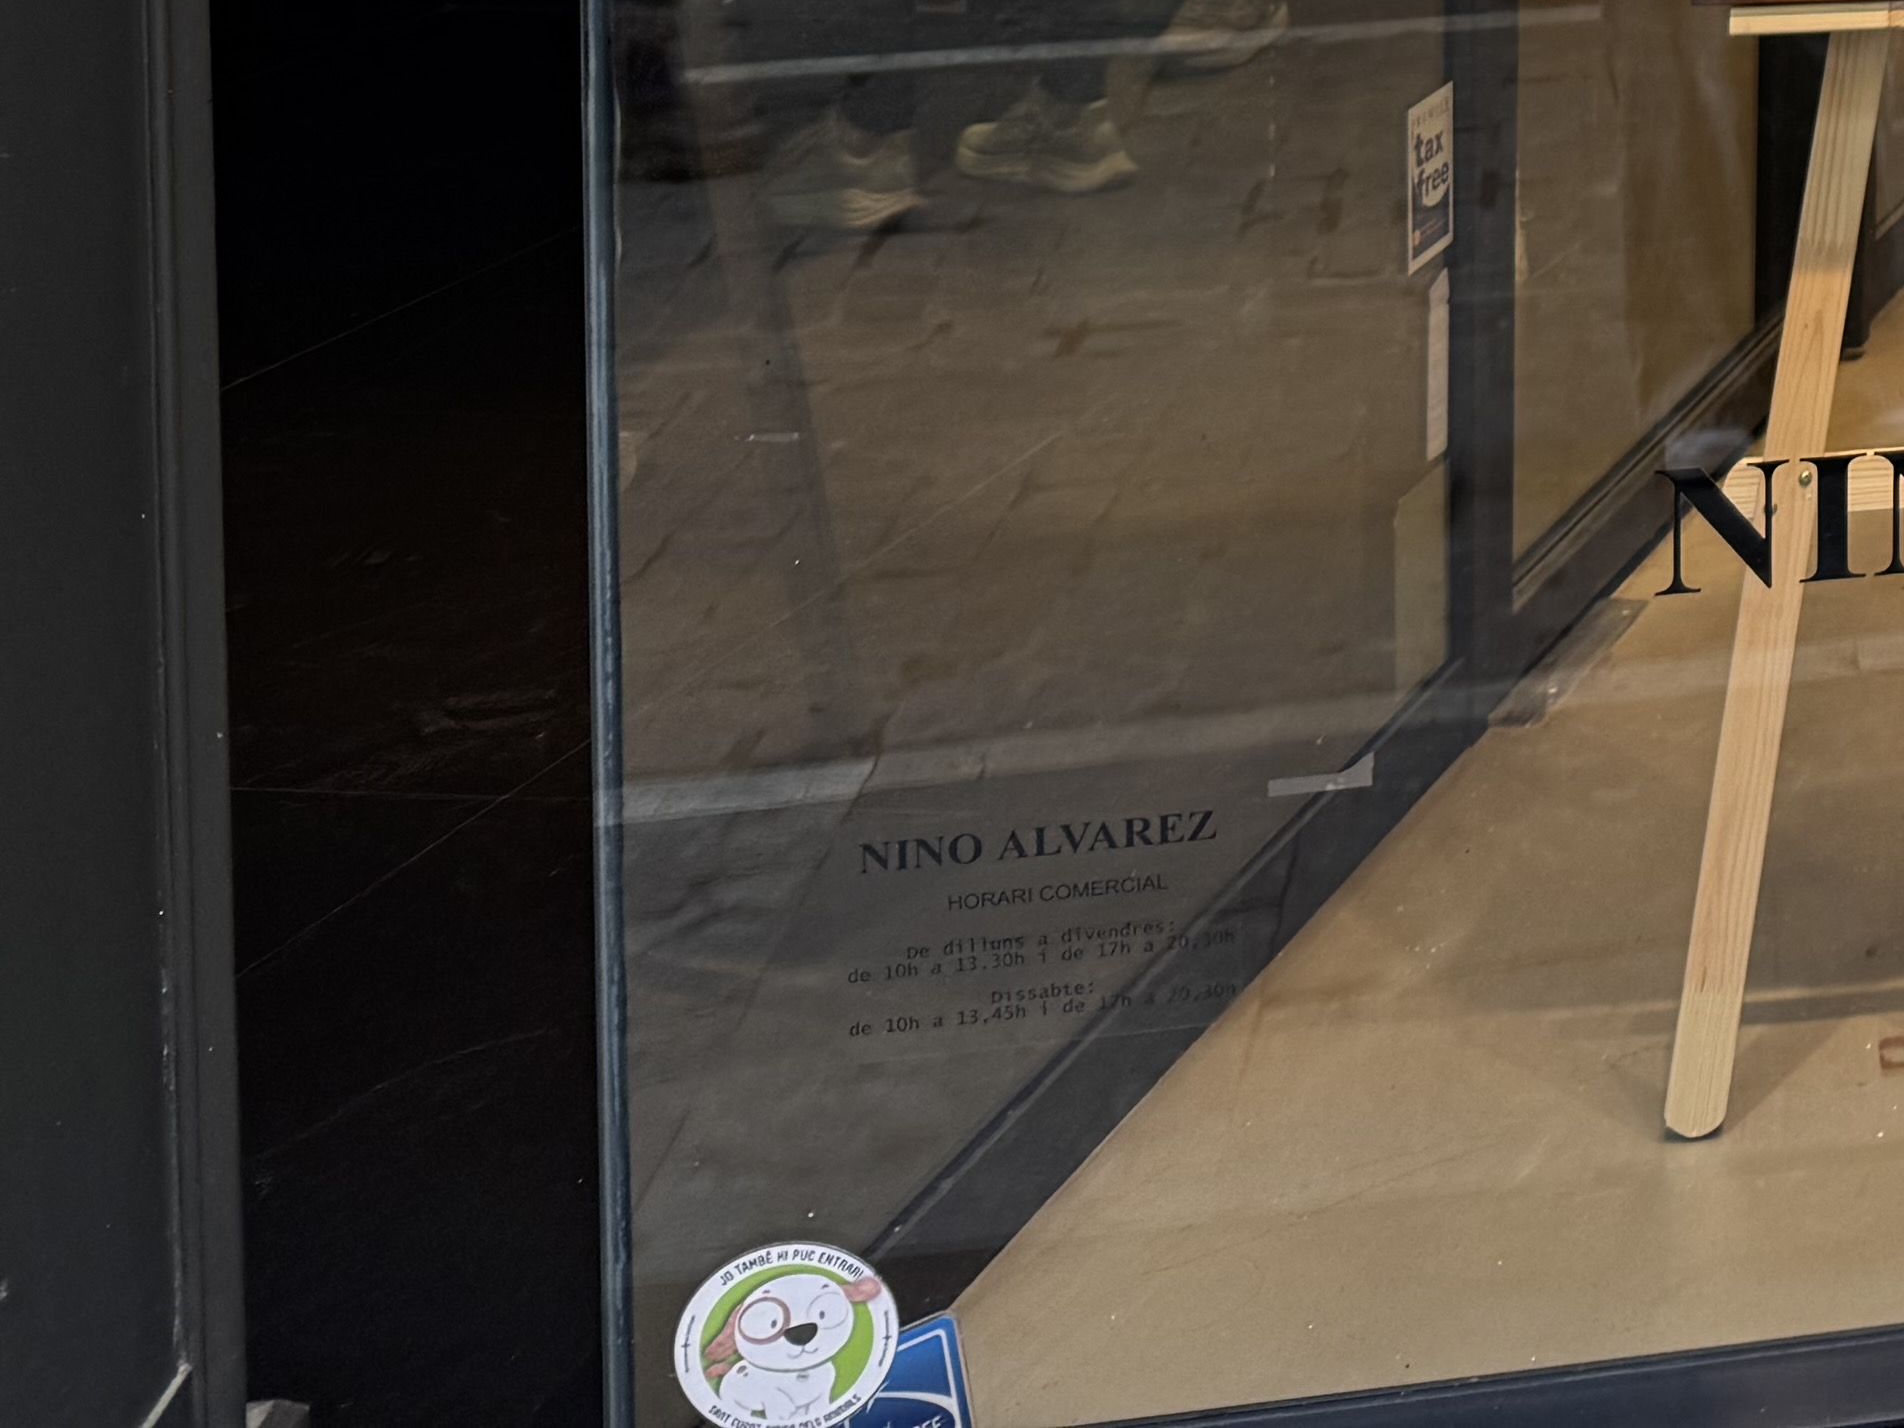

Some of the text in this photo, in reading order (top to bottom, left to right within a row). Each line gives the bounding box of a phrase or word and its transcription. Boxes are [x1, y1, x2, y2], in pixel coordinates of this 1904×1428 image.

[1414, 129, 1444, 169] tax
[1416, 161, 1450, 202] free
[859, 810, 1218, 875] NINO ALVAREZ
[947, 874, 1168, 911] HORARI COMERCIAL
[906, 945, 930, 960] De
[1061, 919, 1175, 944] divendres:
[848, 967, 872, 984] de
[884, 962, 919, 980] 10h
[930, 962, 942, 975] a
[1060, 947, 1084, 962] de
[1099, 940, 1131, 958] 17h
[991, 981, 1095, 1004] Dissabte:
[848, 1020, 872, 1037] de
[886, 1015, 920, 1033] 10h
[932, 1014, 943, 1028] a
[1063, 998, 1086, 1013] de
[719, 1272, 735, 1286] JO
[777, 1250, 789, 1262] HI
[792, 1249, 816, 1261] PUC
